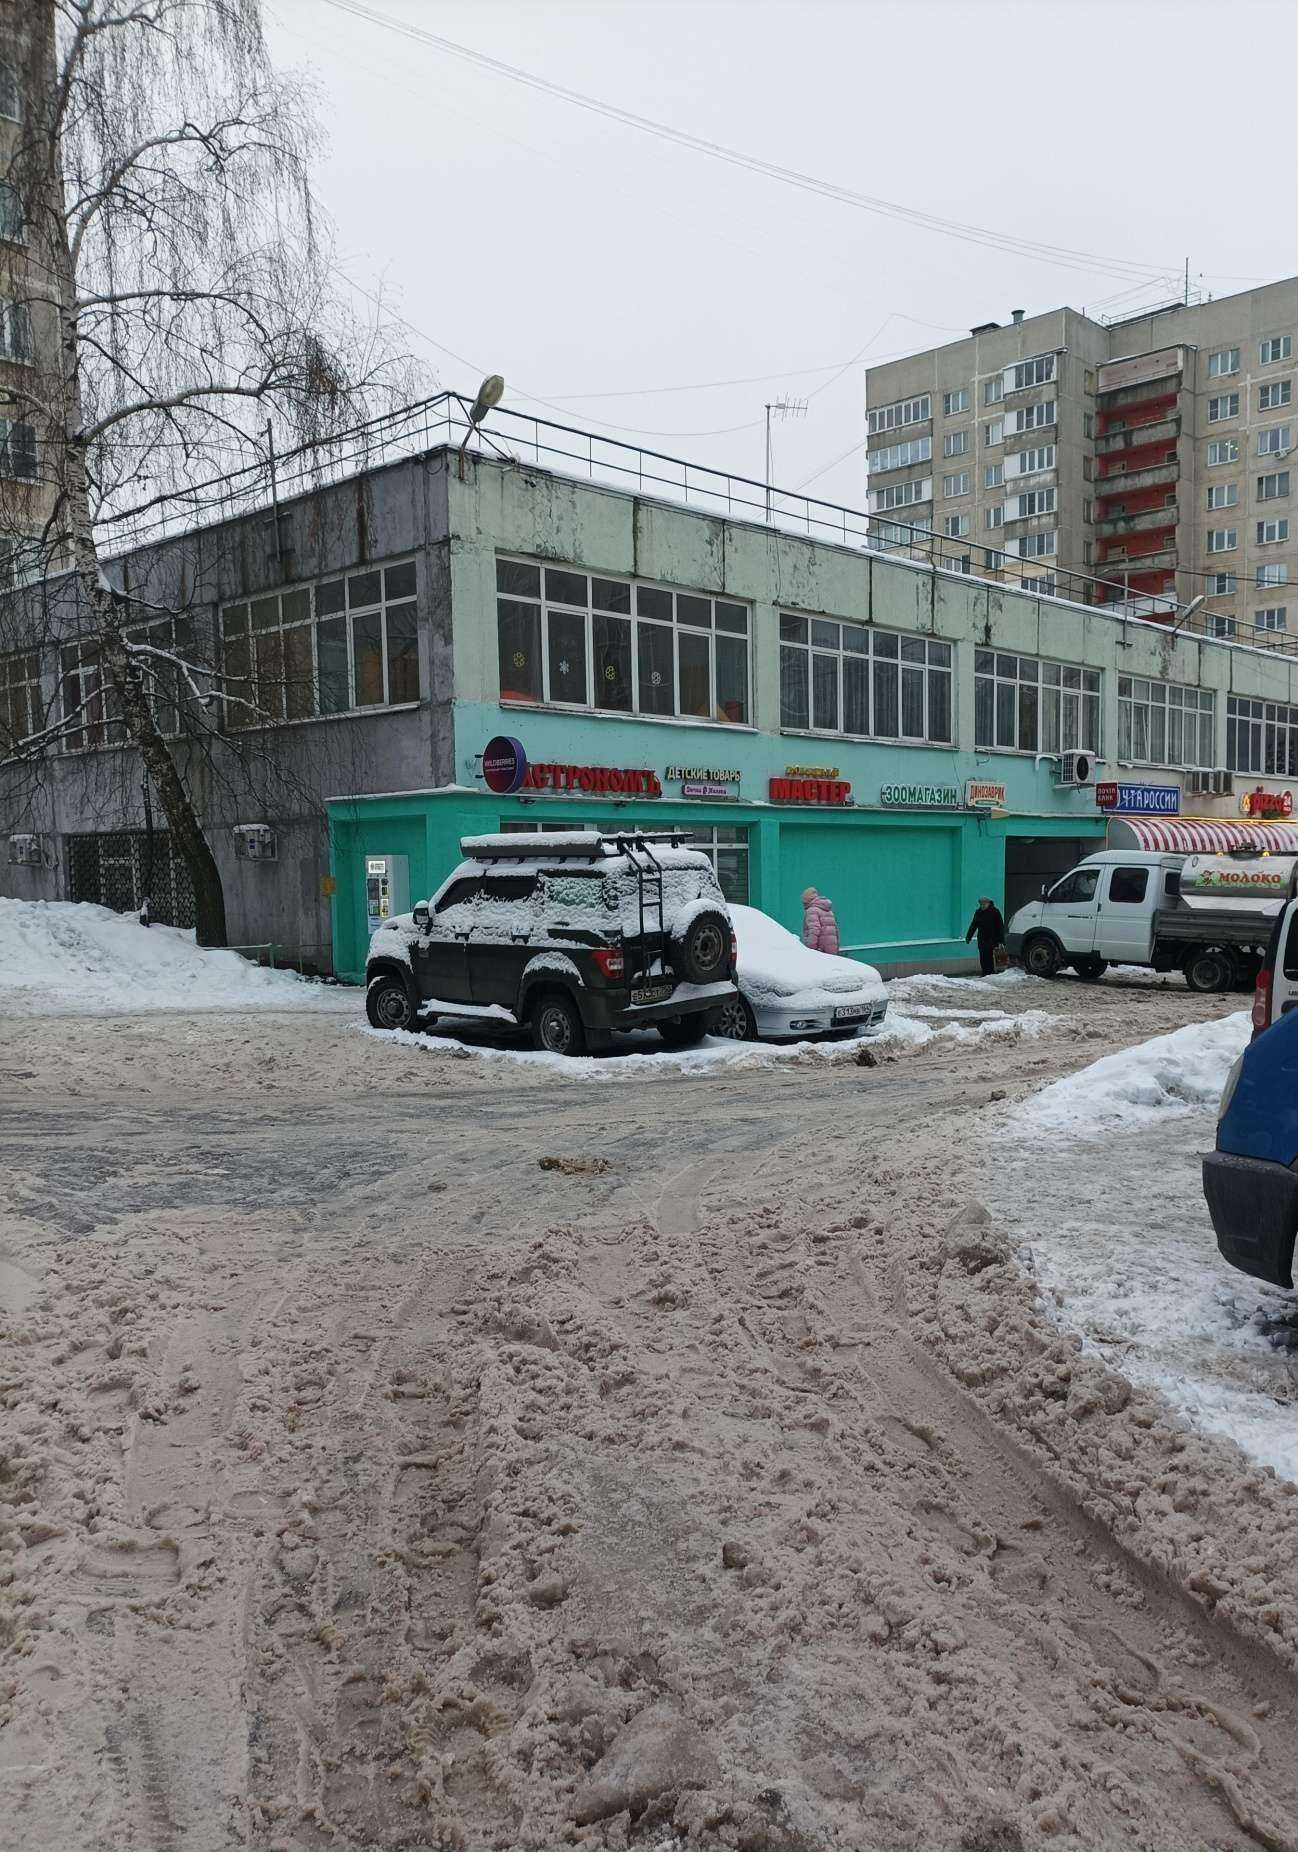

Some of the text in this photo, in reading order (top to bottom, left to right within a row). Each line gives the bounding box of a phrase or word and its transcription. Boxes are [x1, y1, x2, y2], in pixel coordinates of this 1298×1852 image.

[485, 758, 515, 766] WILDBERRIES
[523, 763, 661, 794] АСТРОНОМЪ
[667, 767, 708, 780] ДЕТСКИЕ
[770, 779, 851, 803] МАСТЕР
[886, 784, 957, 805] ЗООМАГАЗИН
[1143, 791, 1177, 810] РОССИИ
[1219, 871, 1281, 883] МОЛОКО
